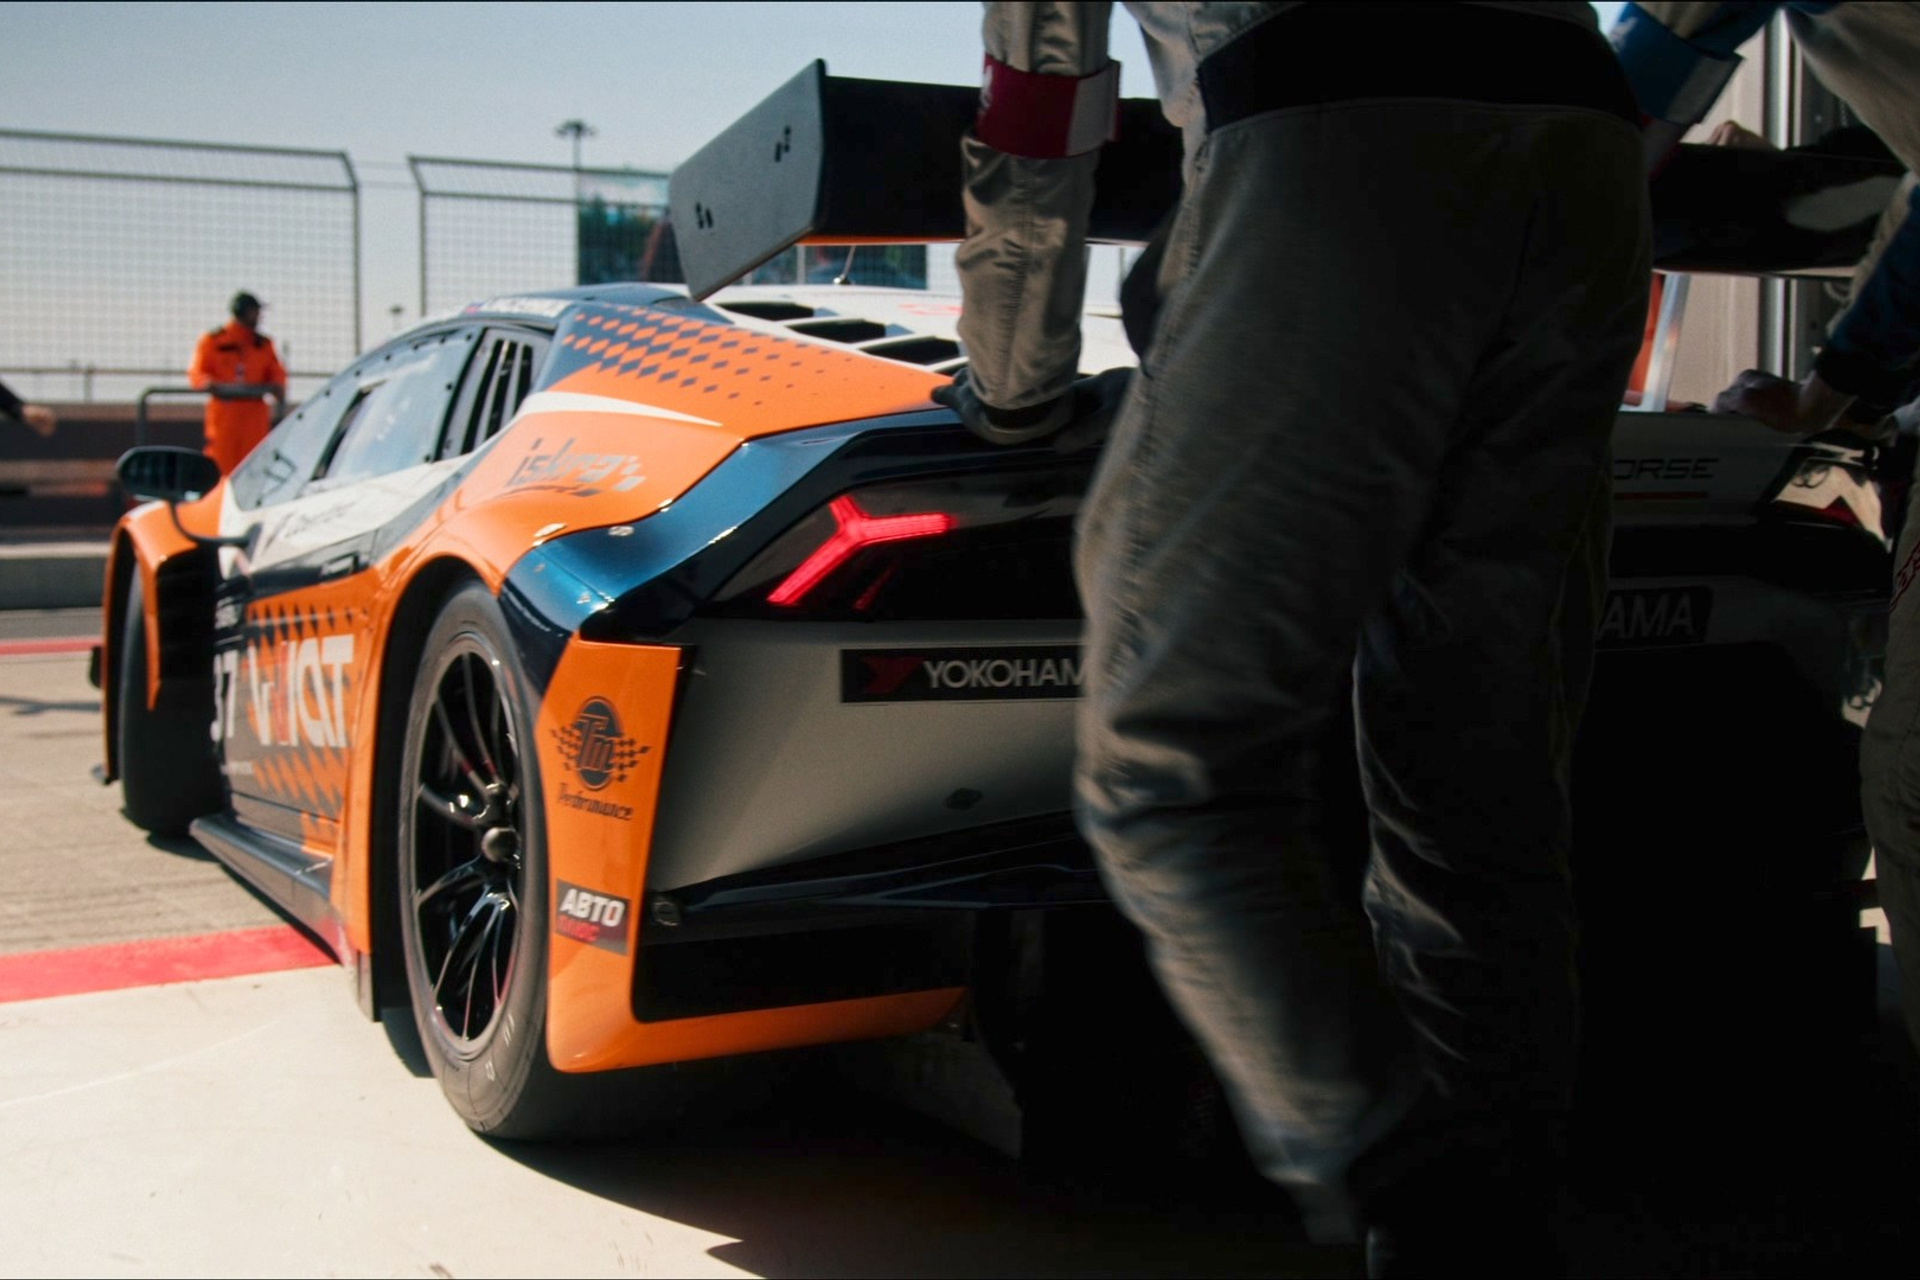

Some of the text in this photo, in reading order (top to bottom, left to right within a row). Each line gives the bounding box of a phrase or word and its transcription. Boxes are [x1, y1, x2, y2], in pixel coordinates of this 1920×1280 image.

[1613, 458, 1719, 480] ORSE
[1597, 593, 1694, 638] AMA
[922, 658, 1087, 689] YOKOHAM
